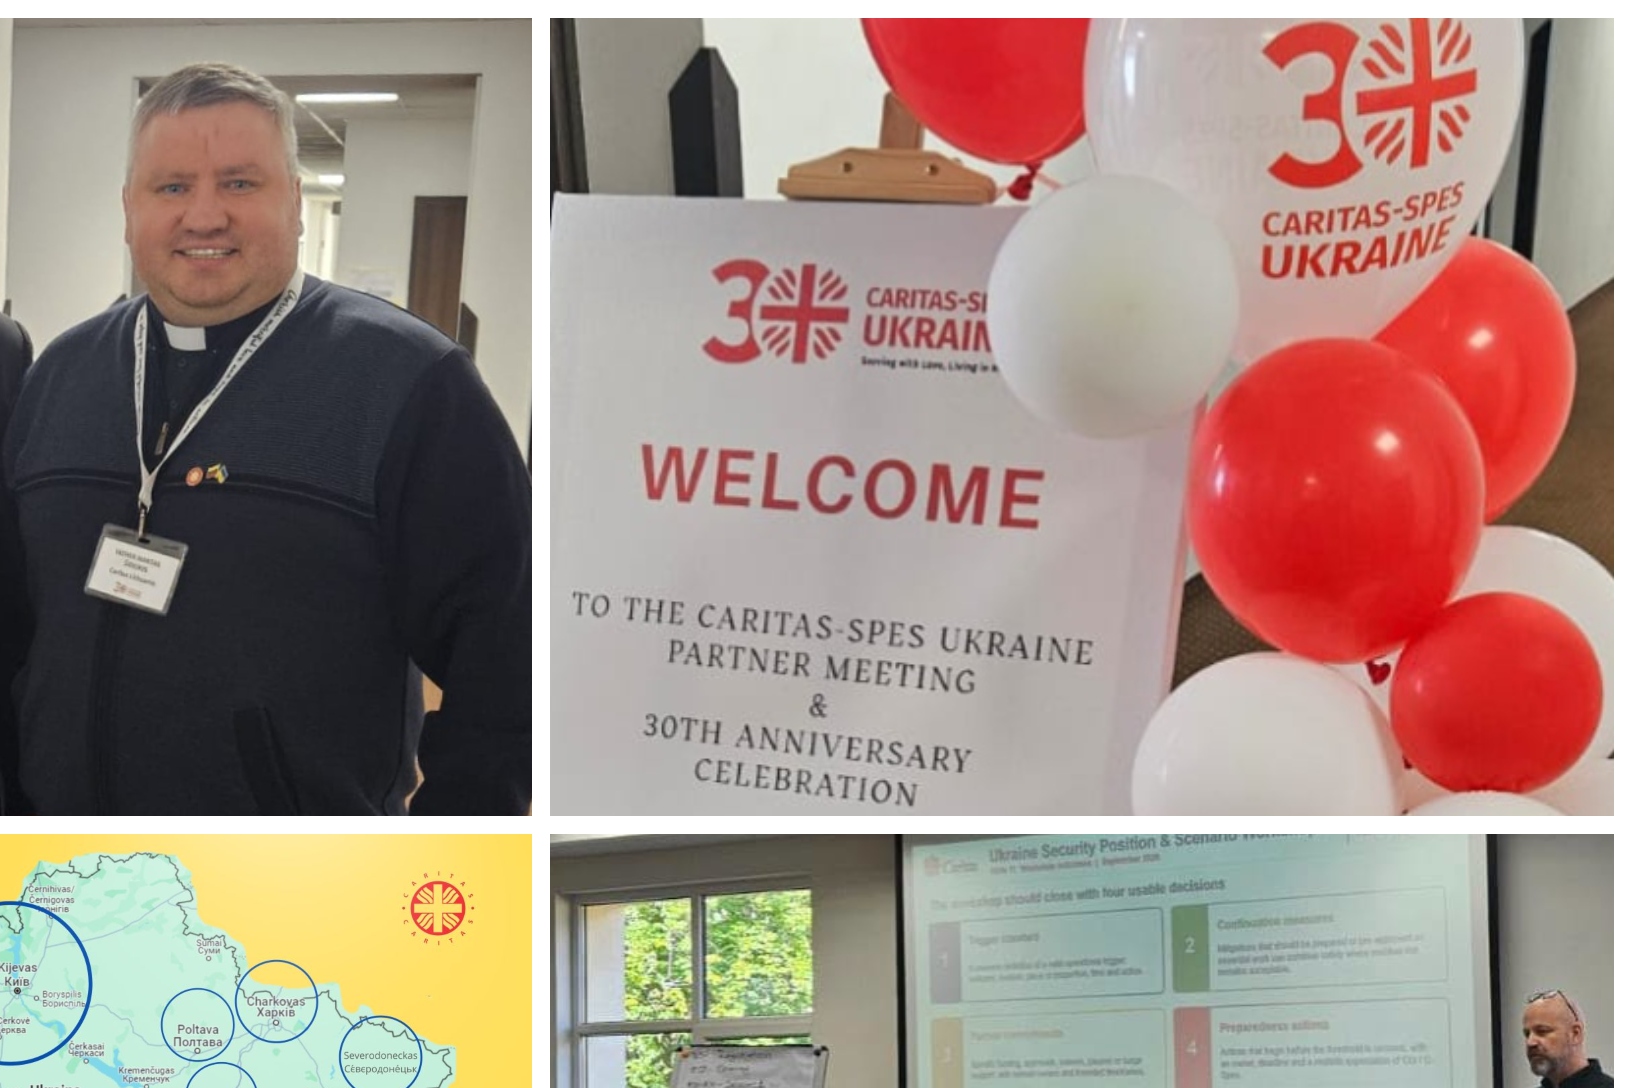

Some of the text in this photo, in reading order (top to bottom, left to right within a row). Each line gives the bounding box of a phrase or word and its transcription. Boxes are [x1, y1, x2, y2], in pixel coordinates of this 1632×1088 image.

[1262, 181, 1465, 236] CARITAS-SPES
[1262, 214, 1456, 279] UKRAINE
[865, 287, 988, 313] CARITAS-S
[863, 315, 992, 353] UKRAIN
[639, 443, 1046, 531] WELCOME
[572, 591, 1094, 666] TO THE CARITAS-SPES UKRAINE
[667, 640, 976, 694] PARTNER MEETING
[808, 693, 828, 718] &
[643, 712, 972, 774] 30TH ANNIVERSARY
[694, 758, 918, 807] CELEBRATION
[1042, 841, 1096, 859] Security
[1100, 835, 1156, 852] Position
[29, 894, 75, 904] Černigovas
[1185, 937, 1195, 953] 2
[4, 977, 30, 986] Київ
[42, 991, 81, 1000] Boryspilis
[247, 996, 305, 1007] Charkovas
[42, 1000, 86, 1008] Бориспіль
[257, 1007, 295, 1019] Харків
[178, 1024, 219, 1034] Poltava
[68, 1041, 104, 1050] Čerkasai
[174, 1037, 222, 1047] Полтава
[344, 1051, 417, 1060] Severodoneckas
[119, 1066, 174, 1075] Kremenčugas
[123, 1075, 170, 1083] Кременчук
